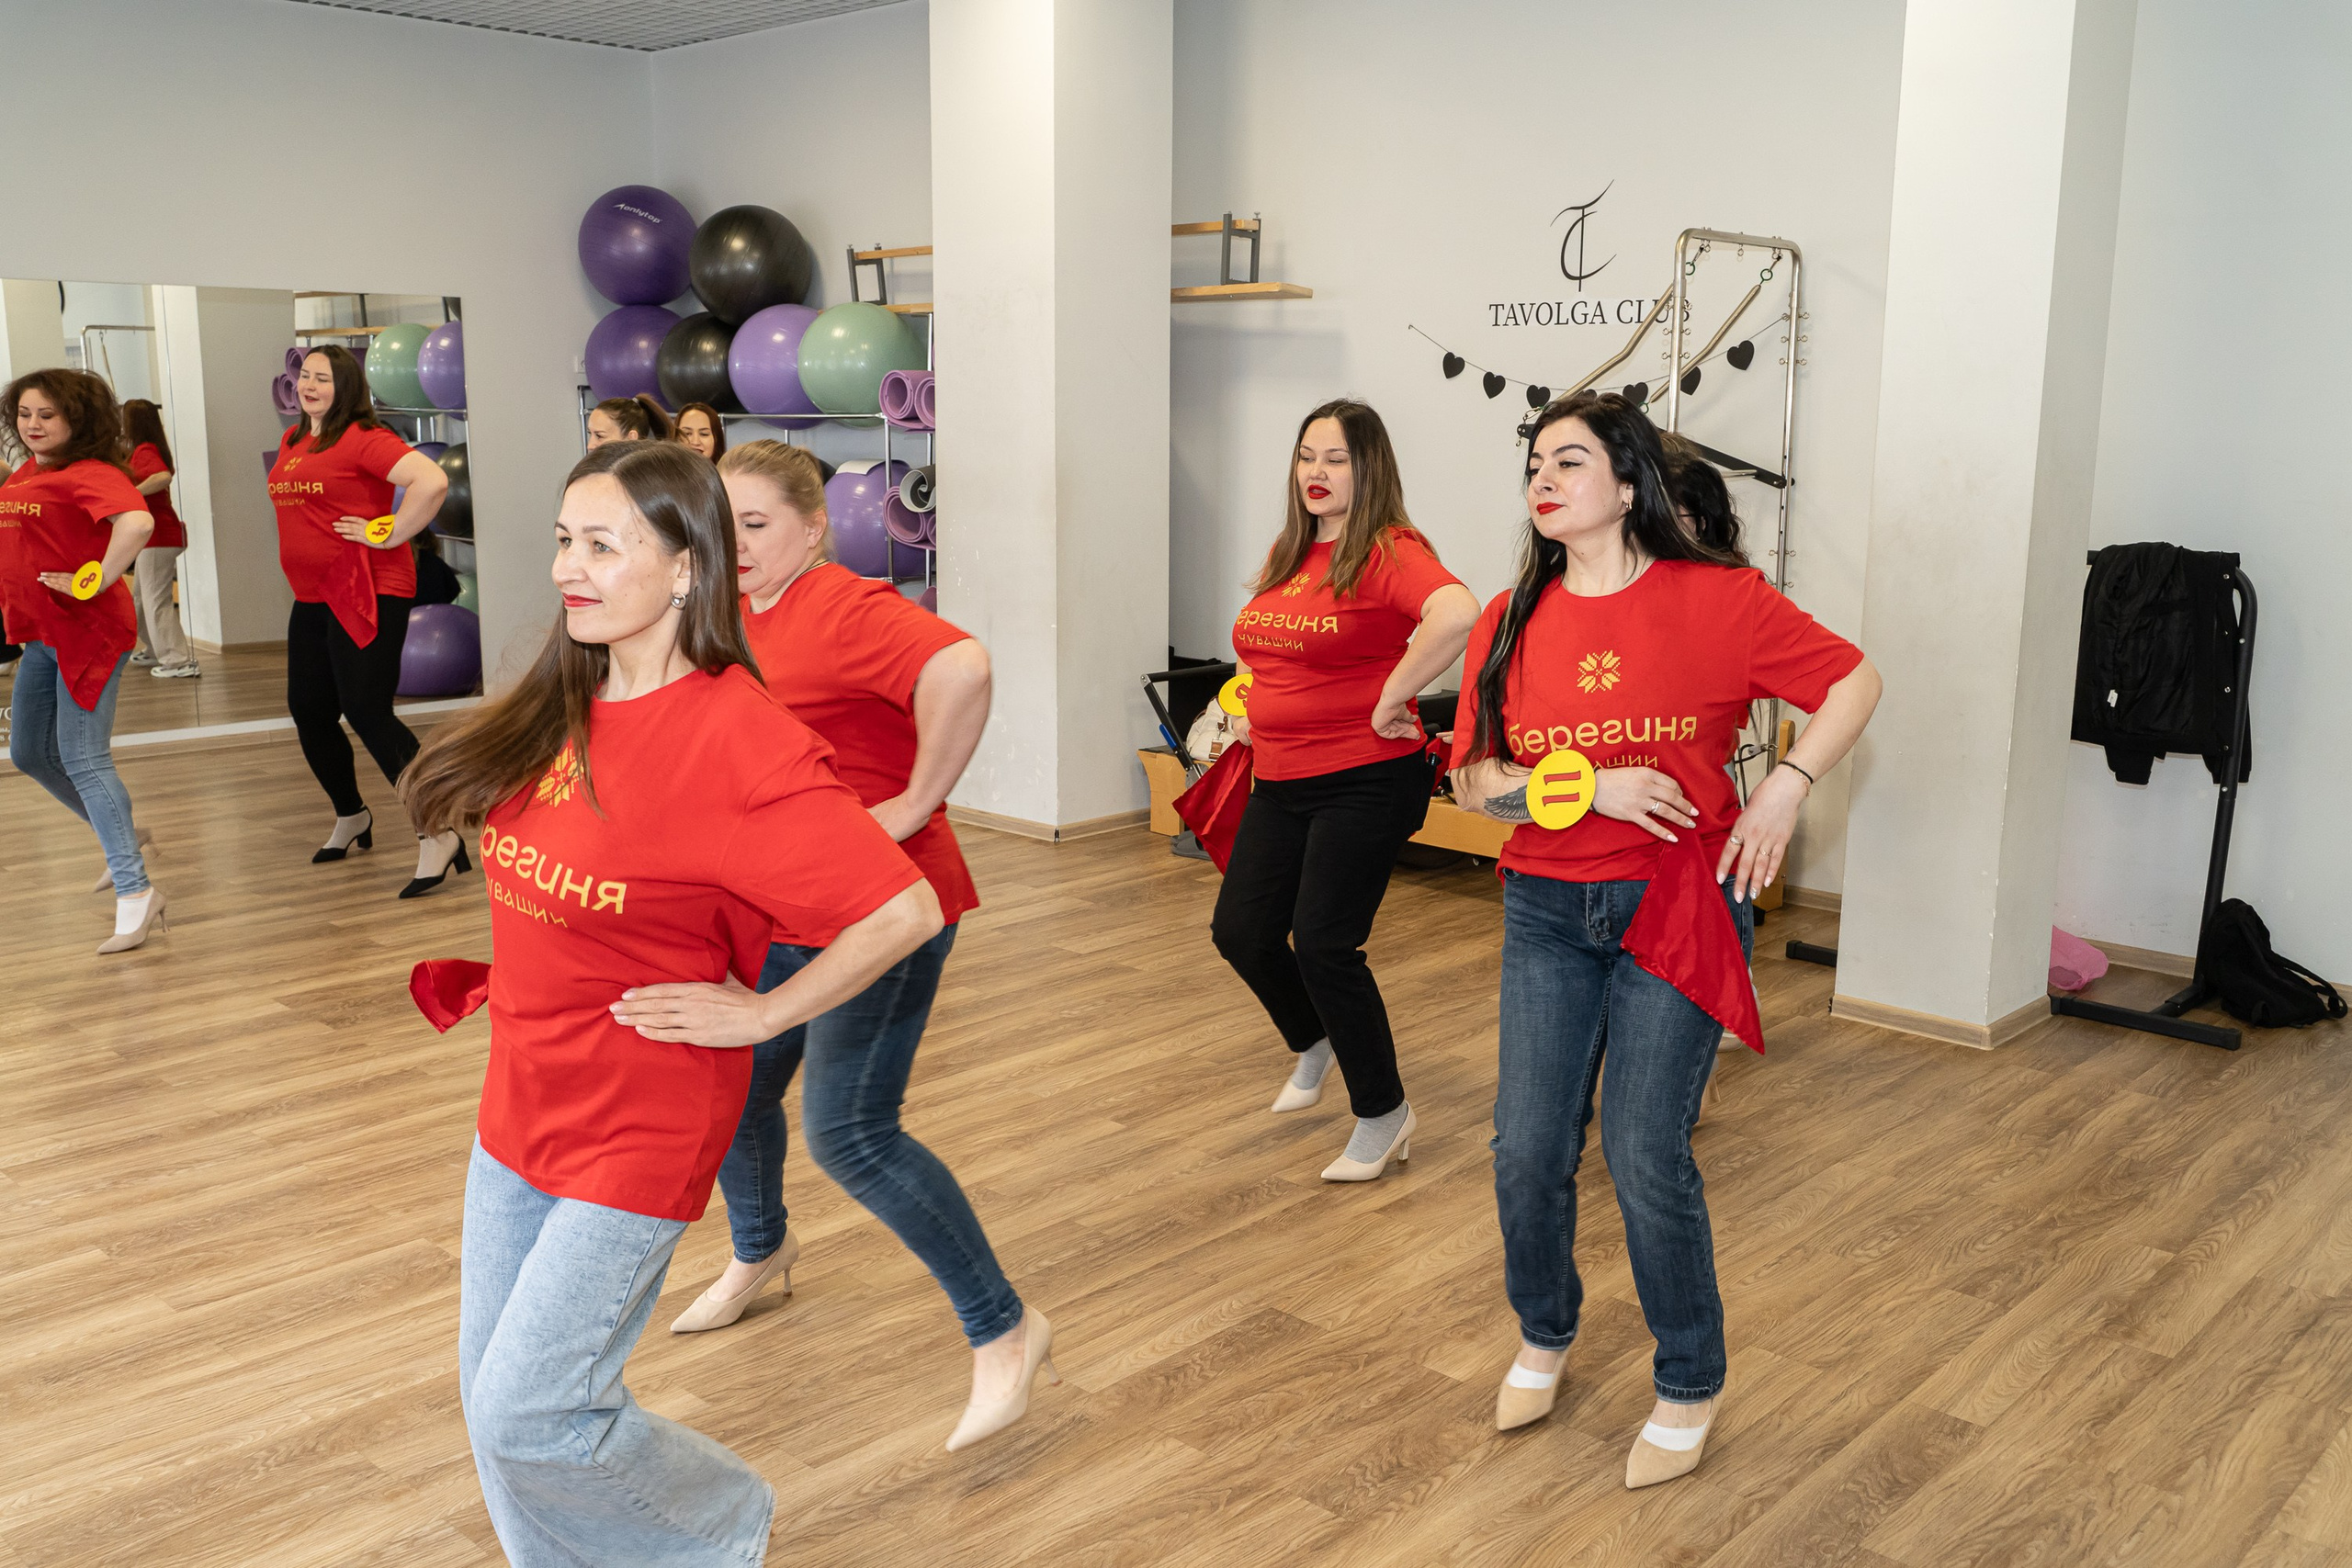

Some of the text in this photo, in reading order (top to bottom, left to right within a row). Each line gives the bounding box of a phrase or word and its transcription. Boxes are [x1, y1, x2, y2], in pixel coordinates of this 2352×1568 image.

[1488, 300, 1608, 327] TAVOLGA
[268, 481, 323, 497] региня
[0, 502, 41, 517] егиня
[79, 571, 97, 590] 8
[1236, 606, 1339, 634] ерегиня
[1508, 716, 1698, 757] берегиня
[1542, 770, 1581, 807] 11
[481, 824, 628, 915] региня
[487, 877, 568, 929] увашии
